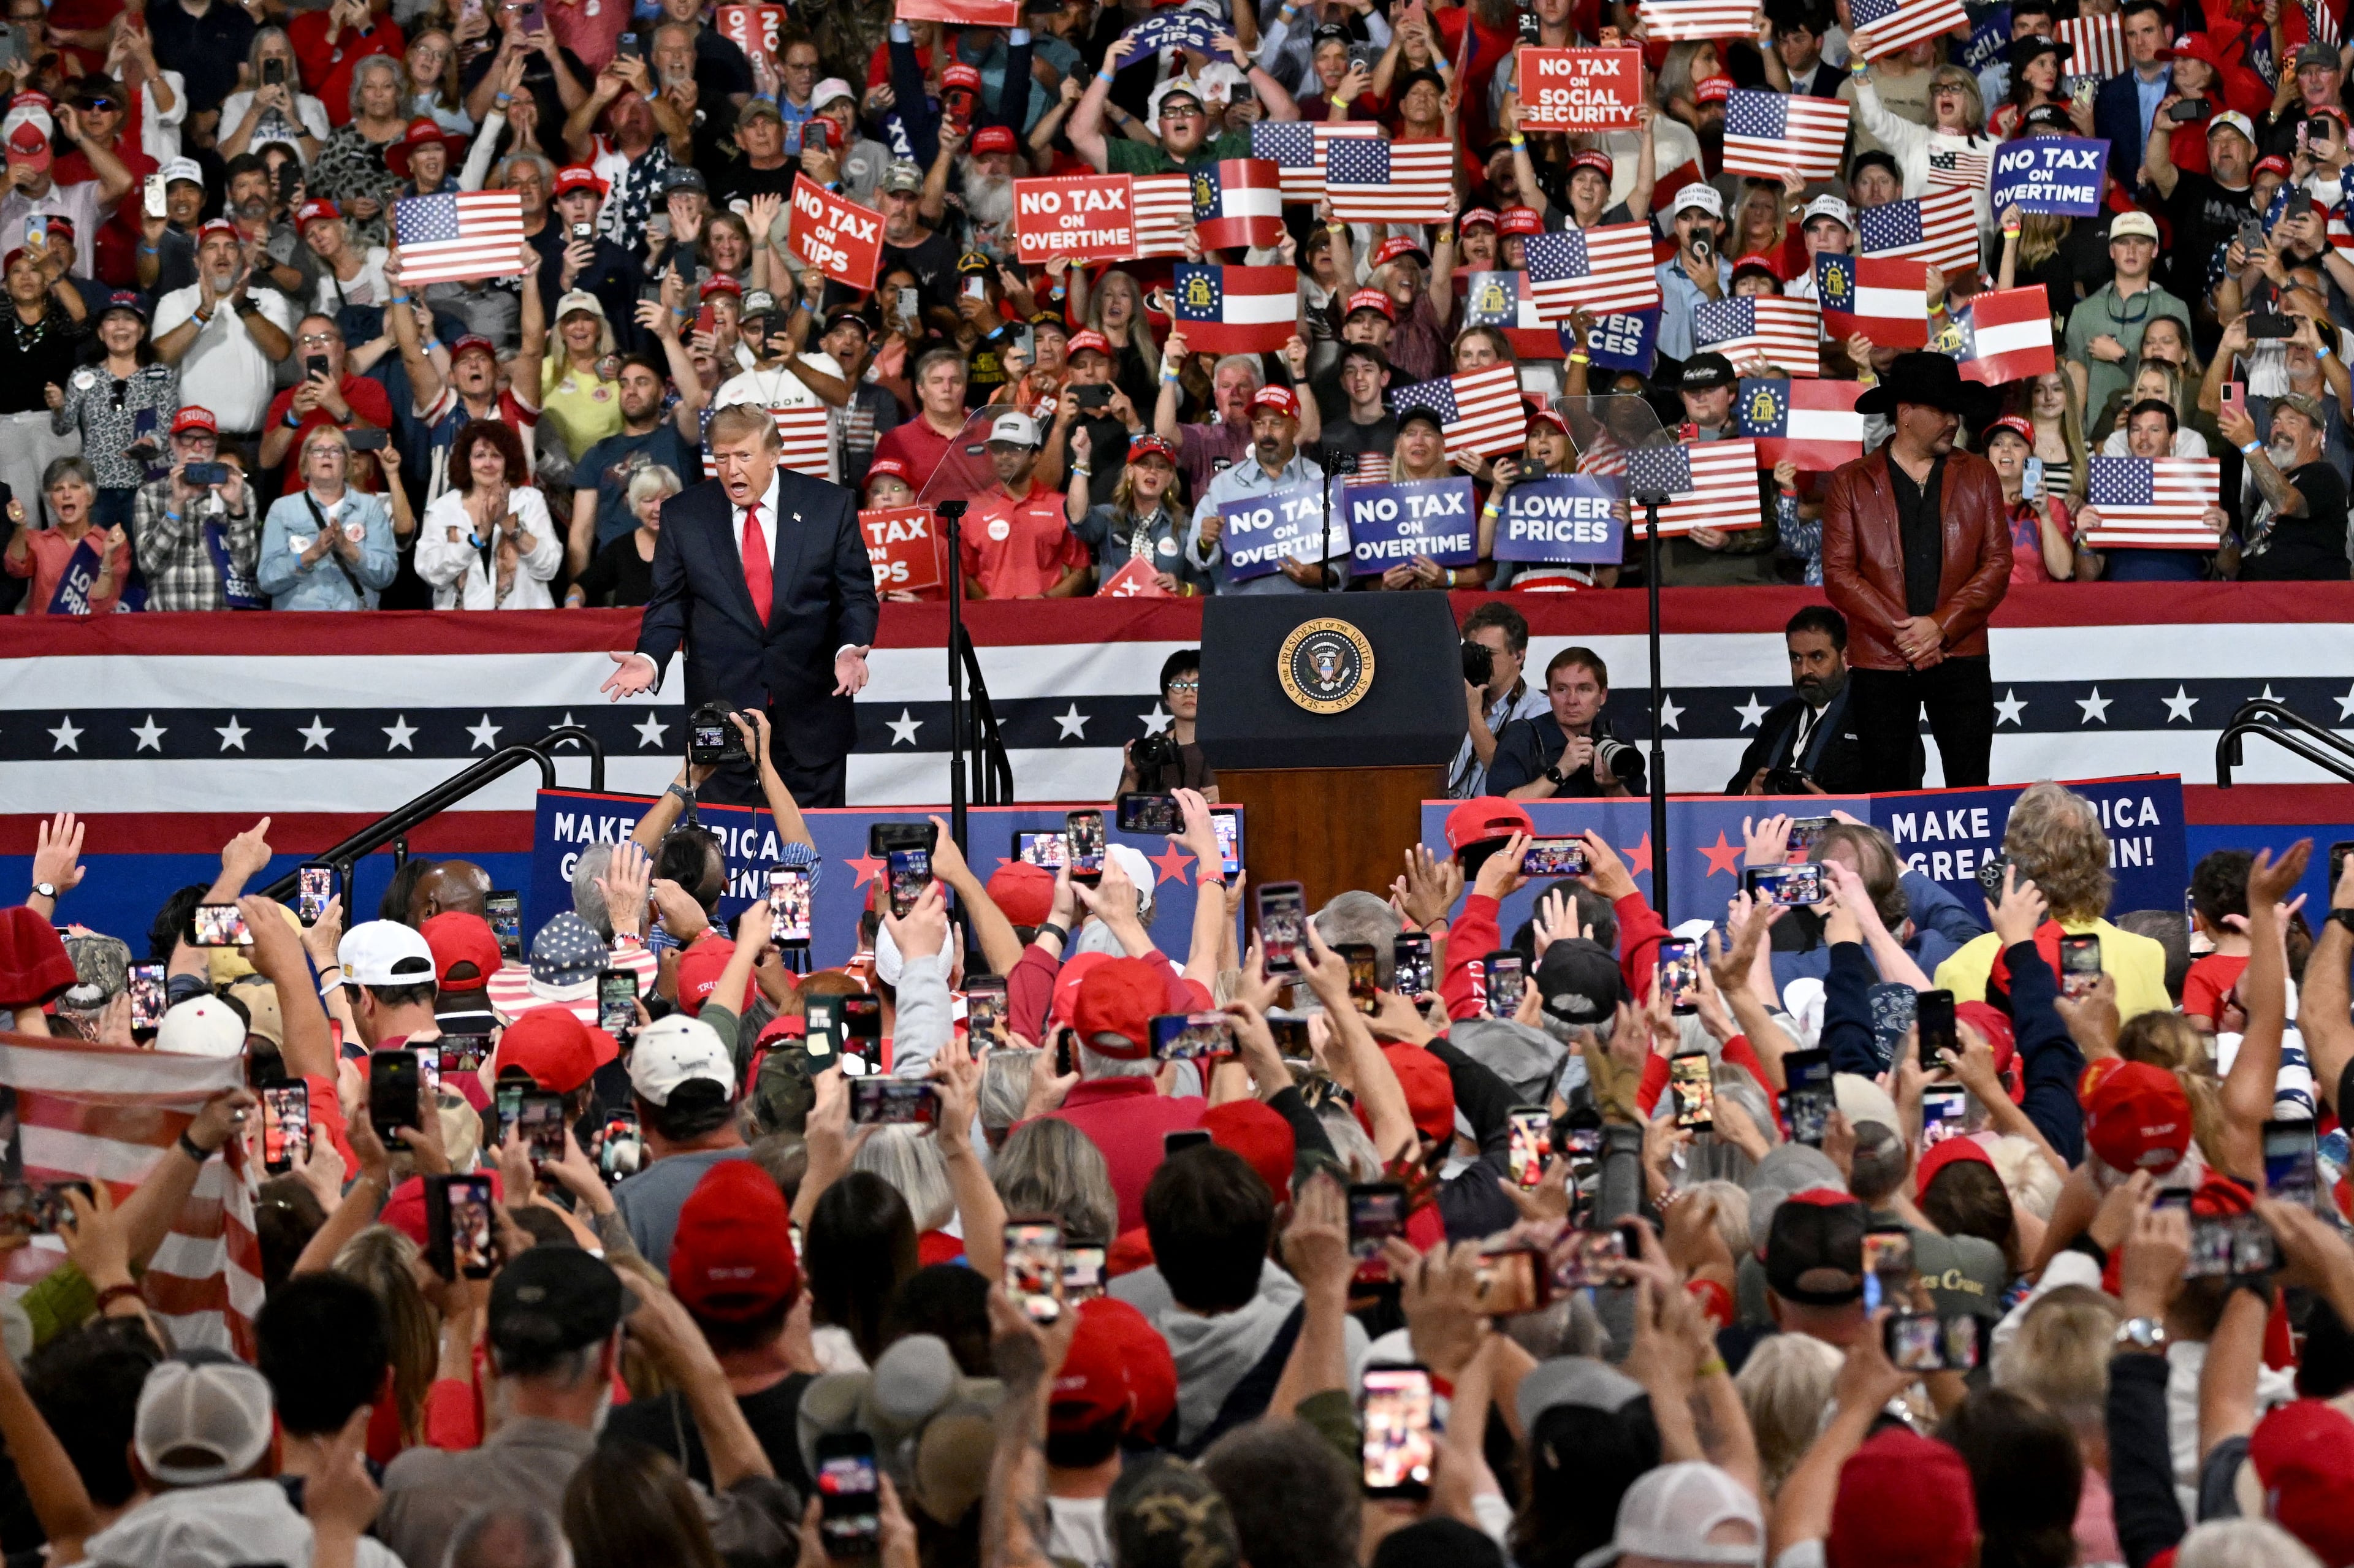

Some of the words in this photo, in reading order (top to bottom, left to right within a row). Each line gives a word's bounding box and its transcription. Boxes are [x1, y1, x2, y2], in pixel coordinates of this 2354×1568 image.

[761, 11, 779, 51] NO
[1129, 17, 1166, 35] NO
[1175, 15, 1226, 33] TAX
[1145, 33, 1204, 47] TIPS
[1964, 28, 2006, 67] TIPS
[1539, 58, 1571, 75] NO
[1577, 58, 1620, 75] TAX
[1569, 77, 1590, 88] ON
[1539, 88, 1621, 106] SOCIAL
[1530, 105, 1634, 123] SECURITY
[1998, 150, 2035, 173] NO
[2043, 148, 2100, 170] TAX
[2028, 169, 2054, 182] ON
[1021, 192, 1063, 214] NO
[1068, 188, 1126, 210] TAX
[1994, 183, 2097, 207] OVERTIME
[796, 187, 824, 219] NO
[828, 205, 877, 244] TAX
[1059, 214, 1085, 228] ON
[815, 225, 836, 245] ON
[1021, 229, 1130, 251] OVERTIME
[801, 234, 848, 272] TIPS
[1228, 509, 1274, 536] NO
[1279, 489, 1338, 521] TAX
[1354, 500, 1398, 525] NO
[1406, 492, 1466, 516] TAX
[1509, 497, 1610, 520] LOWER
[866, 516, 928, 546] TAX
[1273, 522, 1299, 540] ON
[1397, 522, 1423, 536] ON
[1509, 519, 1608, 543] PRICES
[1230, 528, 1344, 569] OVERTIME
[1355, 533, 1470, 560] OVERTIME
[874, 560, 909, 589] PS
[1336, 623, 1349, 633] THE
[1282, 622, 1323, 664] PRESIDENT
[1350, 634, 1371, 670] UNITED
[1284, 668, 1292, 682] THE
[1294, 692, 1319, 709] SEAL
[1336, 679, 1368, 709] STATES
[554, 813, 634, 843] MAKE
[1892, 808, 1991, 844] MAKE
[1908, 847, 2006, 881] GREA
[2109, 837, 2153, 869] IN!
[697, 981, 718, 992] TRU
